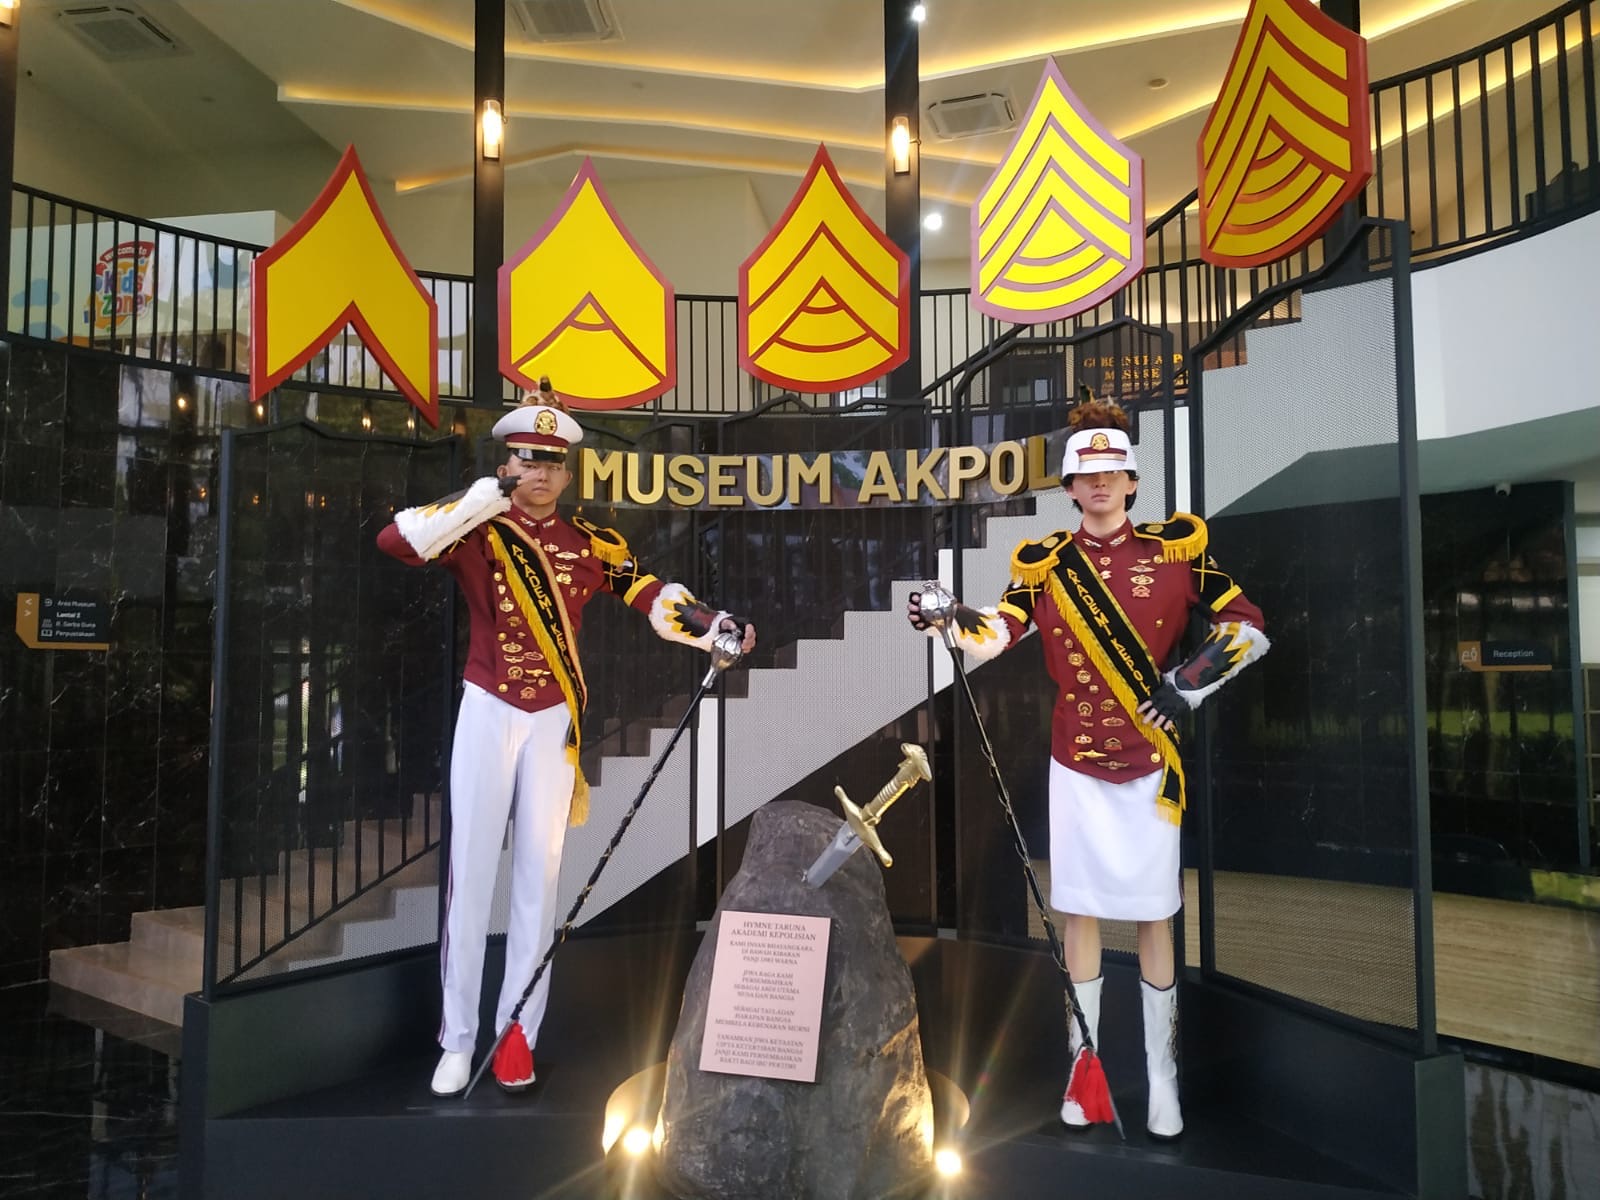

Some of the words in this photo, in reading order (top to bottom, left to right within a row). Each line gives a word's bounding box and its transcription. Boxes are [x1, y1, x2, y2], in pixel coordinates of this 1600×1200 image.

[580, 447, 832, 507] MUSEUM
[857, 436, 1062, 503] AKPOL
[511, 544, 554, 619] AKADEMI
[1066, 568, 1111, 636] AKADEMI
[1493, 648, 1534, 658] Reception
[732, 929, 767, 937] AKADEMI
[770, 932, 816, 940] KEPOLISIAN
